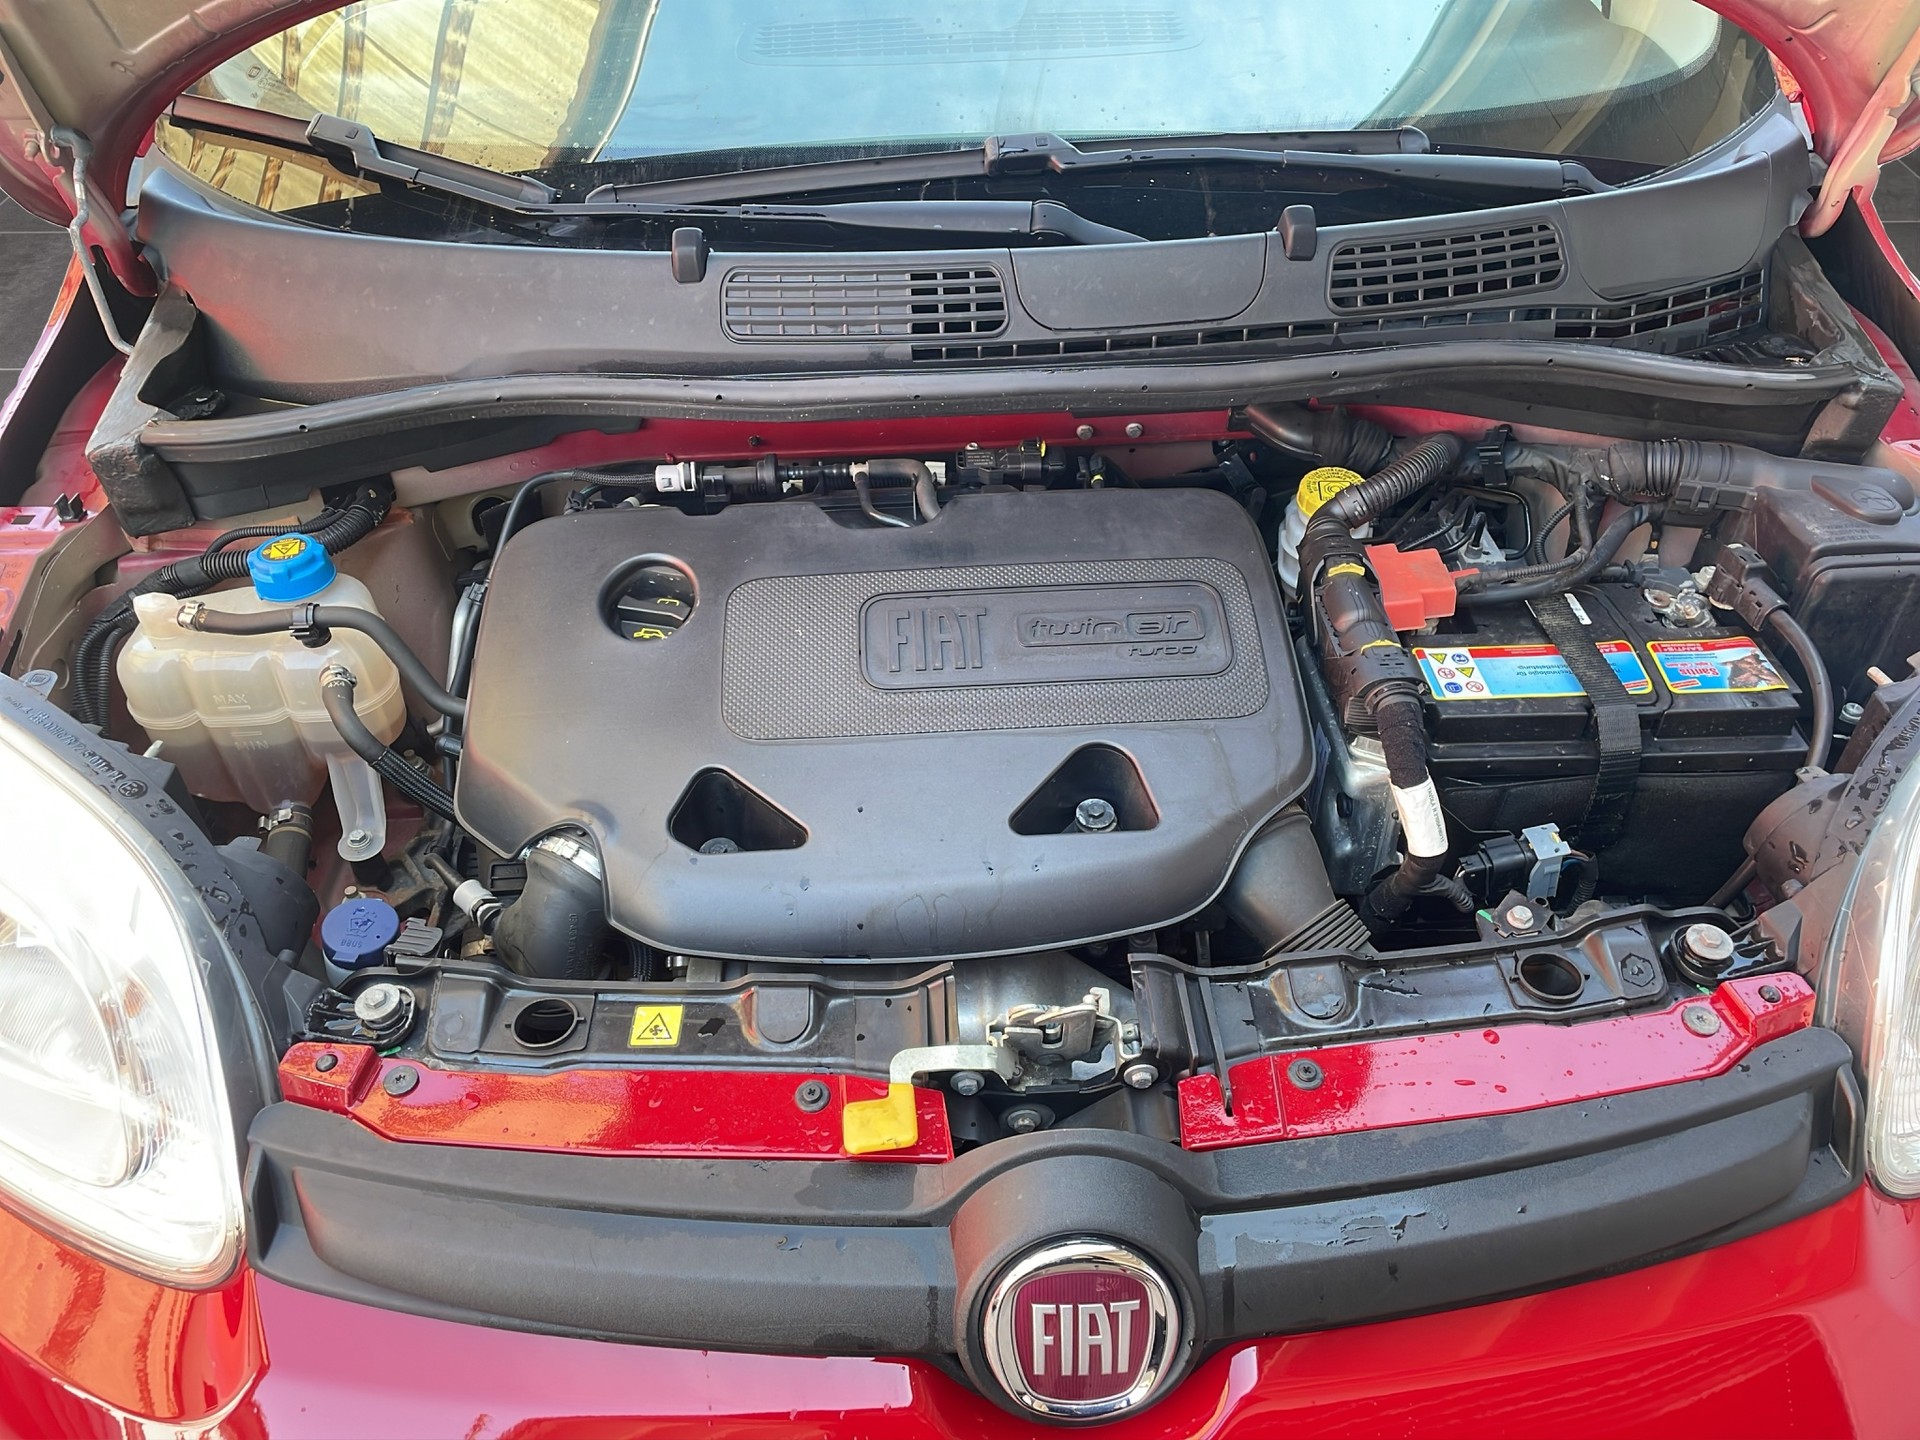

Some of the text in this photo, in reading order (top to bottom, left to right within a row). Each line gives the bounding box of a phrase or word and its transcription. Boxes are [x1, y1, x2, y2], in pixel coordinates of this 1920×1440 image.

[1031, 614, 1190, 638] twin air
[886, 606, 987, 673] FIAT
[1127, 645, 1198, 657] turbo
[212, 693, 249, 705] MAX
[234, 739, 270, 751] MIN
[1031, 1299, 1141, 1377] FIAT
